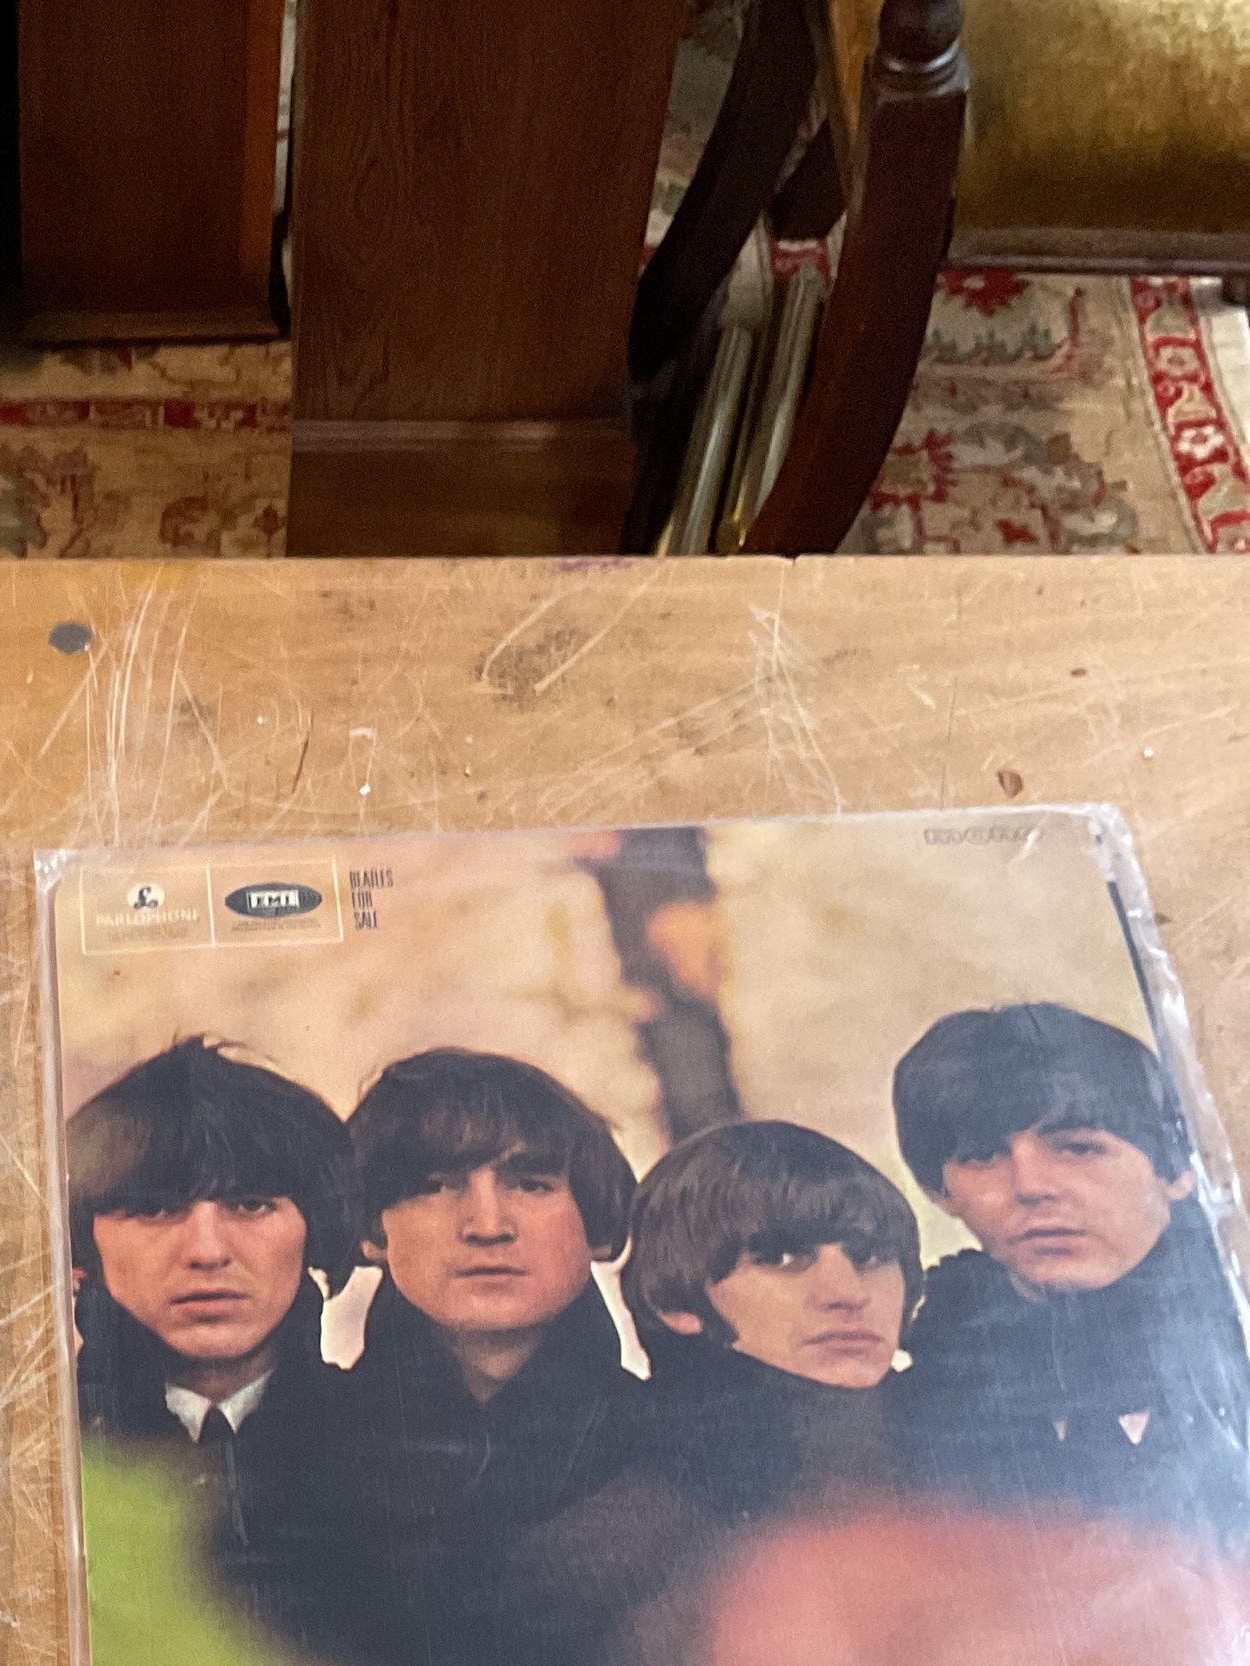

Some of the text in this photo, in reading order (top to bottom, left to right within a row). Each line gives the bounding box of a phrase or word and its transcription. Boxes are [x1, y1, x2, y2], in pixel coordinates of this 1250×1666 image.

[350, 868, 393, 888] BEATLES
[250, 891, 298, 908] EMI
[351, 889, 373, 909] FOR
[354, 911, 378, 930] SALE
